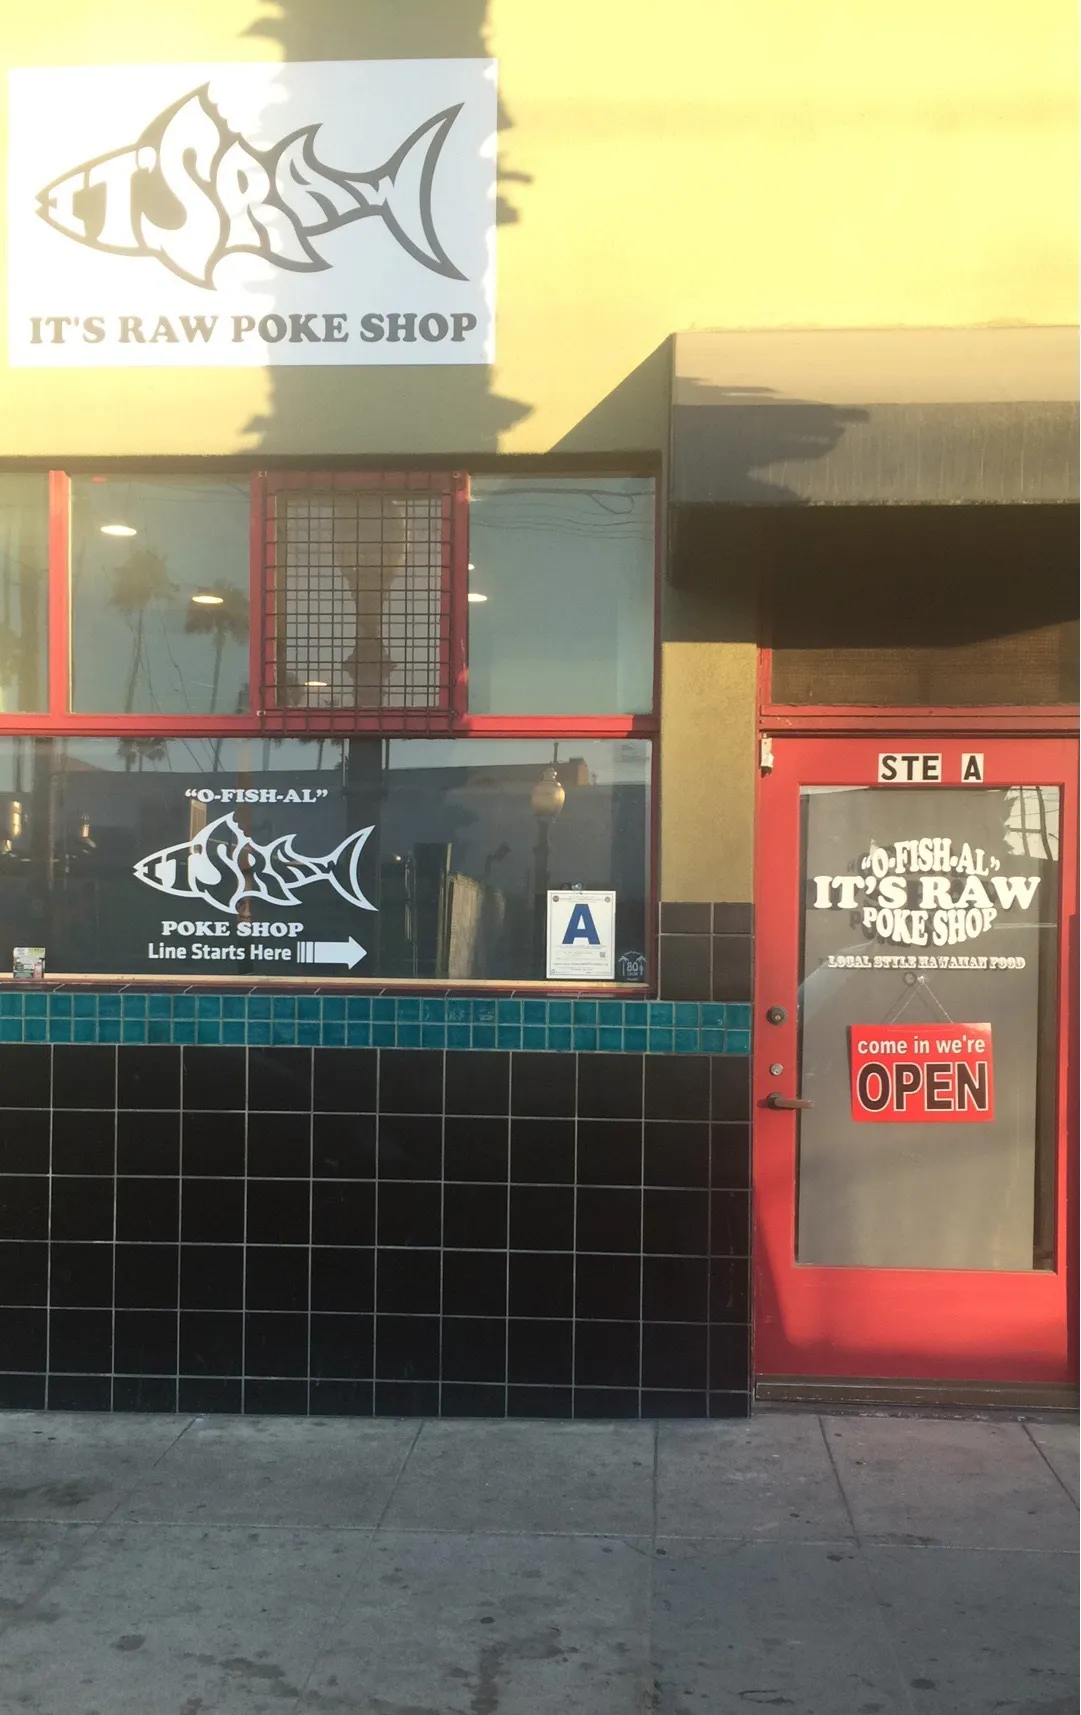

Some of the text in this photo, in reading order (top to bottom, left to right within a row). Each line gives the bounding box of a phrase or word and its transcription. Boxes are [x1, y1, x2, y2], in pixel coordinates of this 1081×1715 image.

[30, 312, 477, 344] IT'S RAW POKE SHOP
[881, 755, 982, 781] STE A
[814, 875, 1041, 910] IT’S RAW
[161, 921, 304, 937] POKE SHOP
[562, 904, 601, 945] A
[863, 907, 998, 946] POKE SHOP
[148, 943, 292, 961] Line Starts Here
[827, 955, 872, 968] LOCAL
[873, 956, 917, 969] STYLE
[989, 956, 1026, 969] FOOD
[857, 1035, 986, 1054] come in we're
[856, 1061, 988, 1112] OPEN
